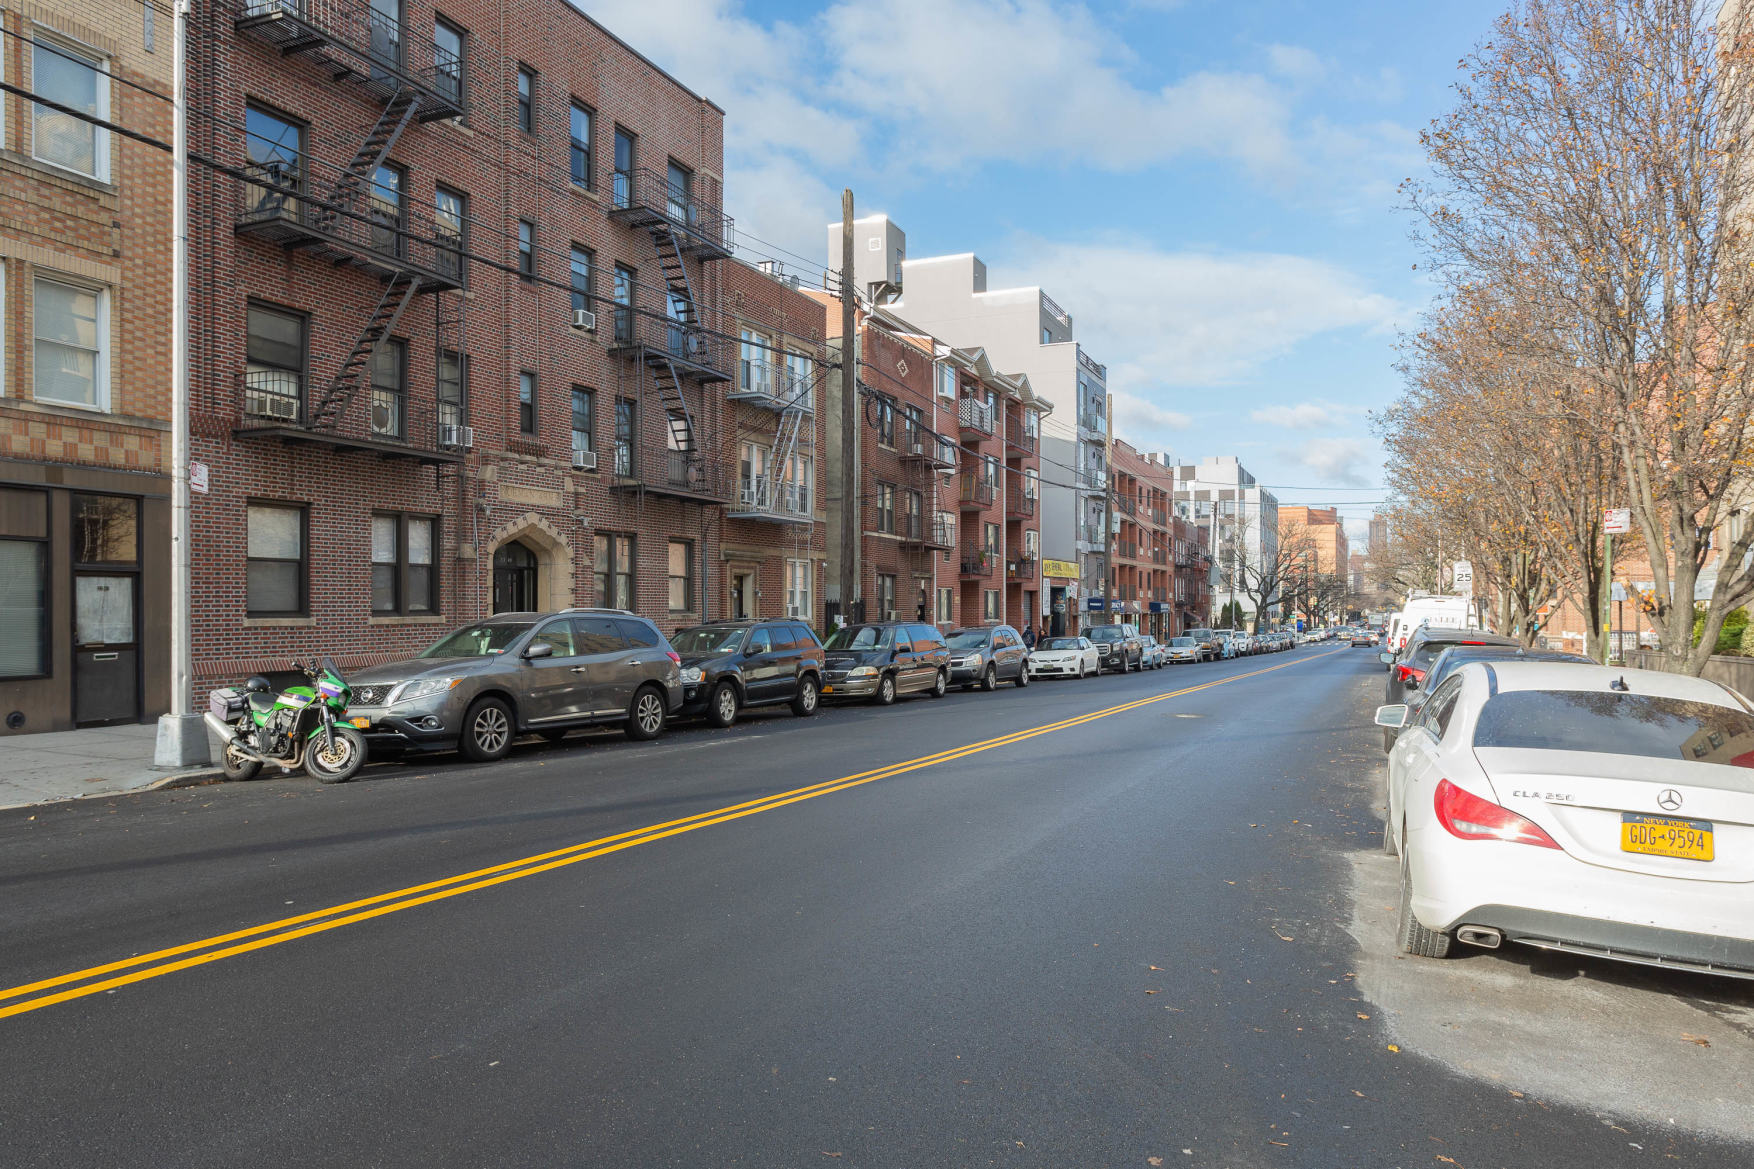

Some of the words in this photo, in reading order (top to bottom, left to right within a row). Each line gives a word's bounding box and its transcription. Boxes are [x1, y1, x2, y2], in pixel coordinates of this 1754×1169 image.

[1457, 573, 1472, 582] 25
[1513, 790, 1540, 799] CLA
[1643, 817, 1667, 826] NEW
[1667, 820, 1691, 829] YORK
[1642, 846, 1668, 855] EMPIRE
[1669, 849, 1691, 857] STATE
